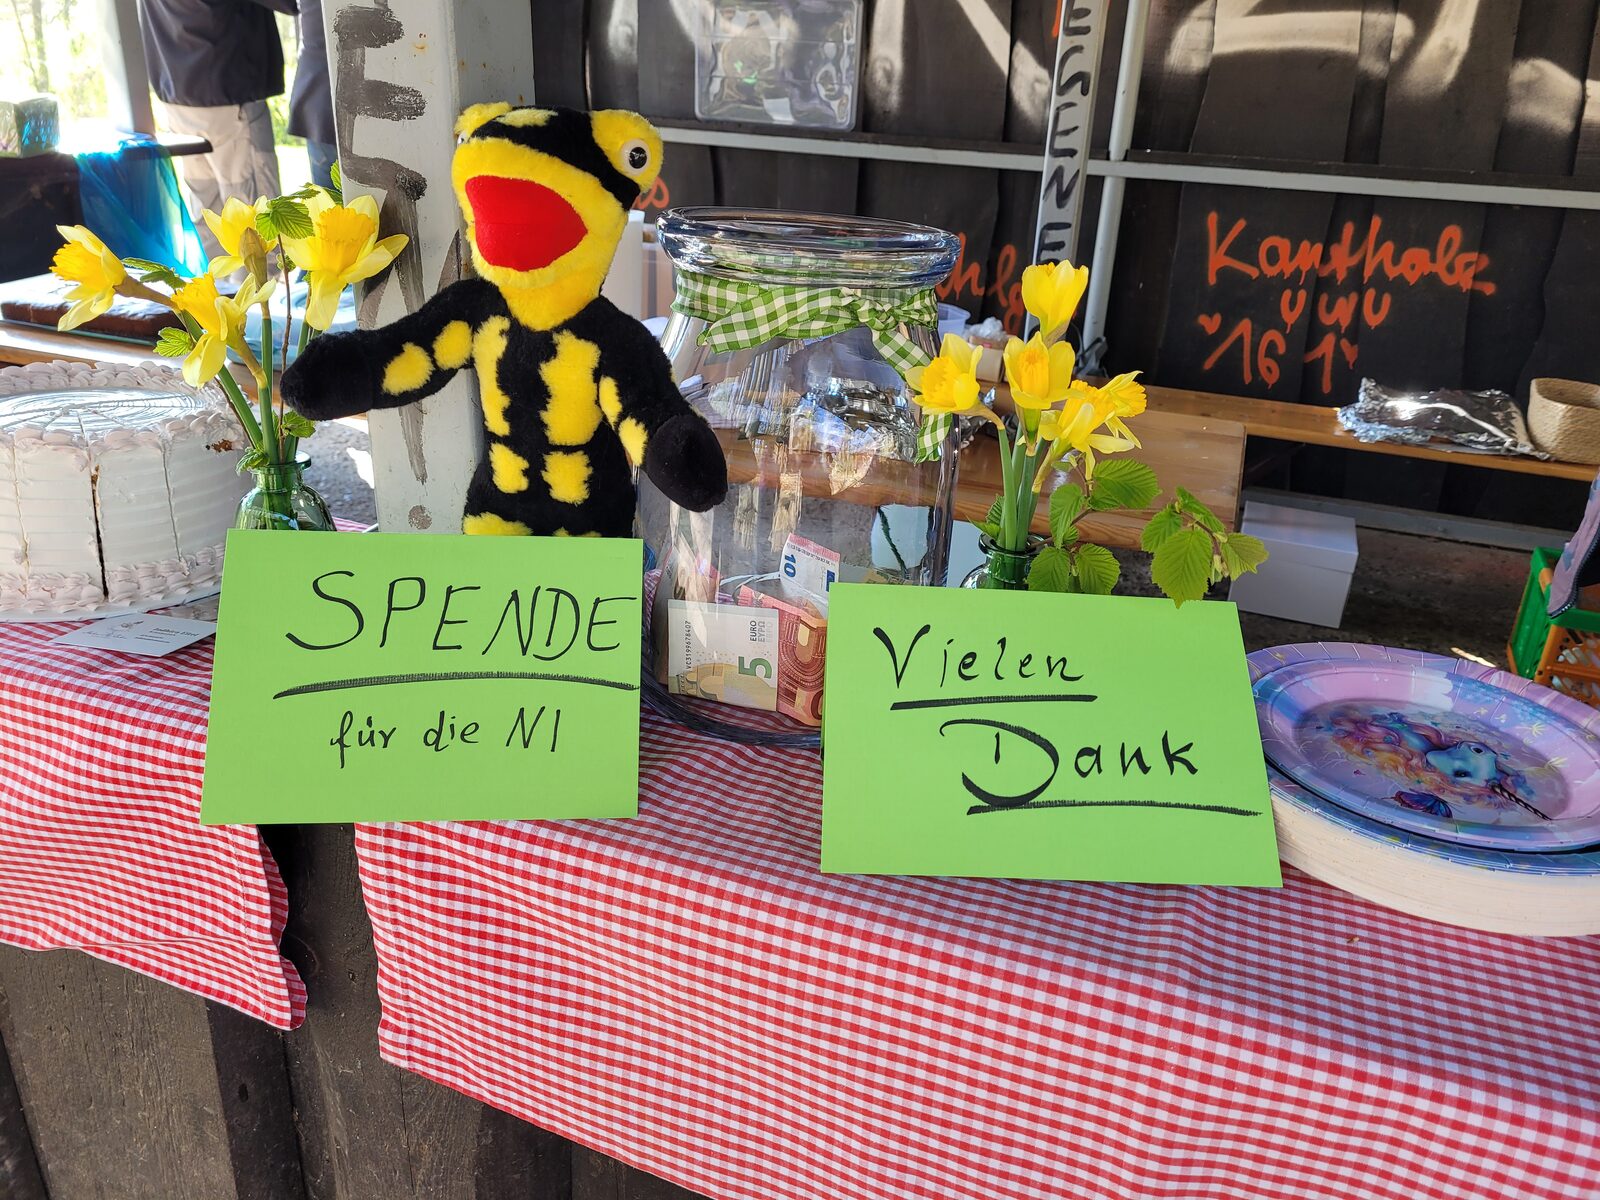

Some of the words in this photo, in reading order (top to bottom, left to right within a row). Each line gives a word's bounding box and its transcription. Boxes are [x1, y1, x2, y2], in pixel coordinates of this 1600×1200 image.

[783, 553, 797, 578] 10
[285, 570, 638, 661] SPENDE
[749, 620, 757, 642] EURO
[738, 655, 773, 679] 5
[872, 623, 1085, 689] Vielen
[329, 709, 398, 769] für
[423, 709, 480, 752] die
[938, 718, 1199, 807] Dank
